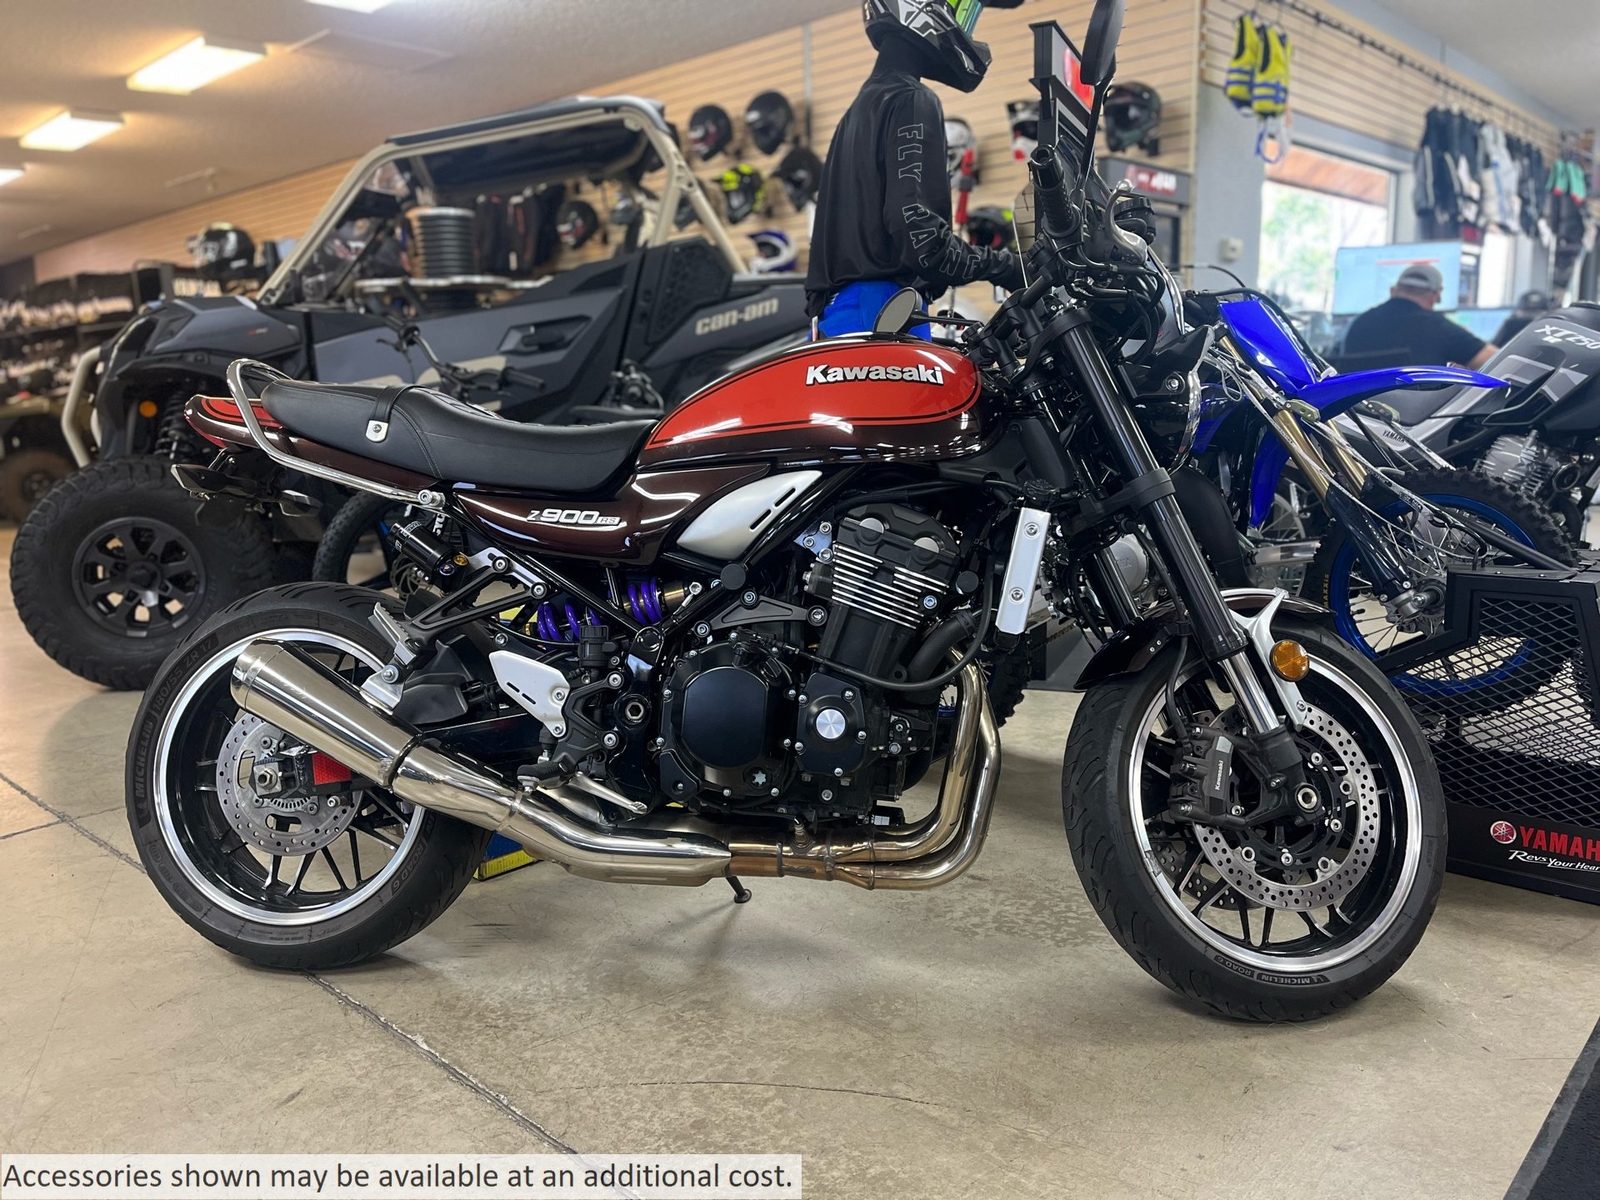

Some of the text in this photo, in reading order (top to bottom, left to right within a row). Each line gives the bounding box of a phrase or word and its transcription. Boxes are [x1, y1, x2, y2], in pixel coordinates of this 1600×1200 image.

[898, 123, 981, 279] FLY RANG
[695, 297, 779, 335] can-am
[1533, 324, 1600, 350] XT250
[805, 363, 945, 386] Kawasaki
[1322, 573, 1330, 609] MAXXIS
[152, 667, 184, 712] 180/55
[134, 719, 155, 797] MICHELIN
[1214, 759, 1224, 791] Kawasaki
[400, 841, 425, 882] ROAD
[1508, 849, 1548, 864] Revs
[1547, 857, 1576, 868] Your
[1519, 826, 1600, 862] YAMAH
[1224, 961, 1253, 977] ROAD
[1260, 974, 1312, 985] MICHELIN
